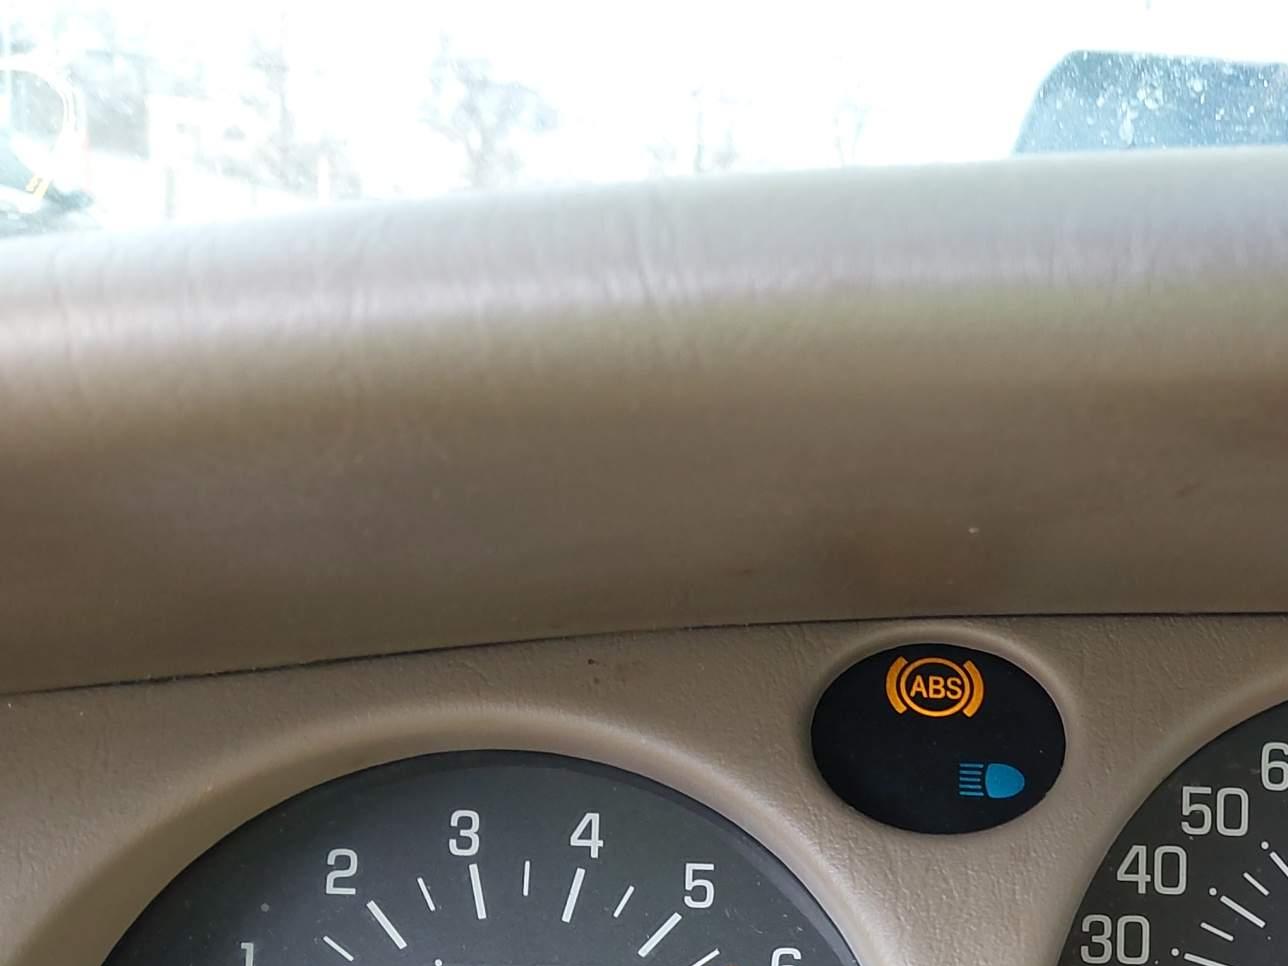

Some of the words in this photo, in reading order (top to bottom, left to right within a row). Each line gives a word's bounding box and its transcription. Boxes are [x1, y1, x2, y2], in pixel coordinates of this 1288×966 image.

[910, 675, 963, 700] ABS
[448, 809, 480, 857] 3
[1181, 786, 1249, 837] 50
[570, 812, 604, 859] 4
[325, 848, 358, 895] 2
[684, 863, 715, 909] 5
[1116, 845, 1187, 895] 40
[1080, 914, 1150, 965] 30
